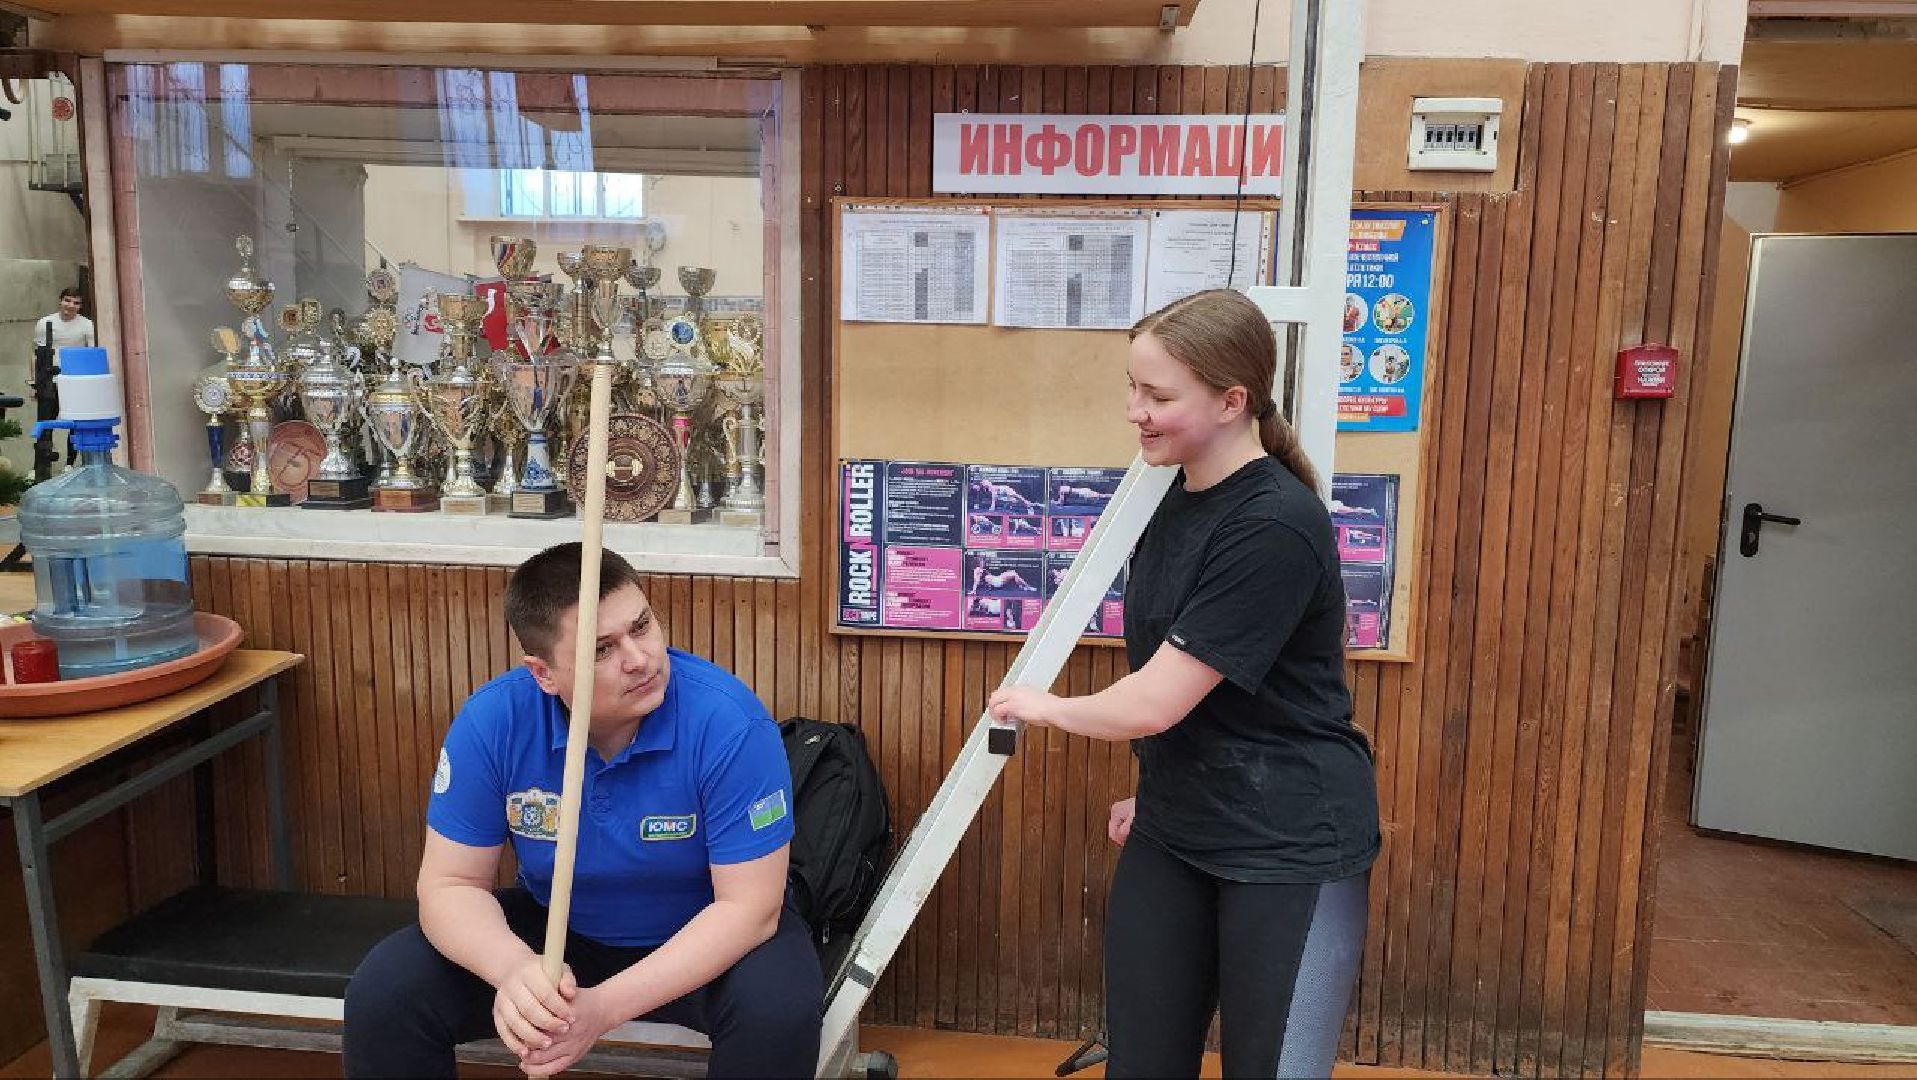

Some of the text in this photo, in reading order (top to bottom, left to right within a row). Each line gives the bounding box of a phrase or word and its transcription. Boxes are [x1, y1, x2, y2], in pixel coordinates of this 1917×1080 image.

[959, 123, 1282, 185] ИНФОРМАЦИ
[1346, 274, 1394, 288] РЯ 12:00
[850, 464, 874, 536] ROLLER
[848, 550, 872, 605] ROCK
[648, 821, 688, 832] ЮМС
